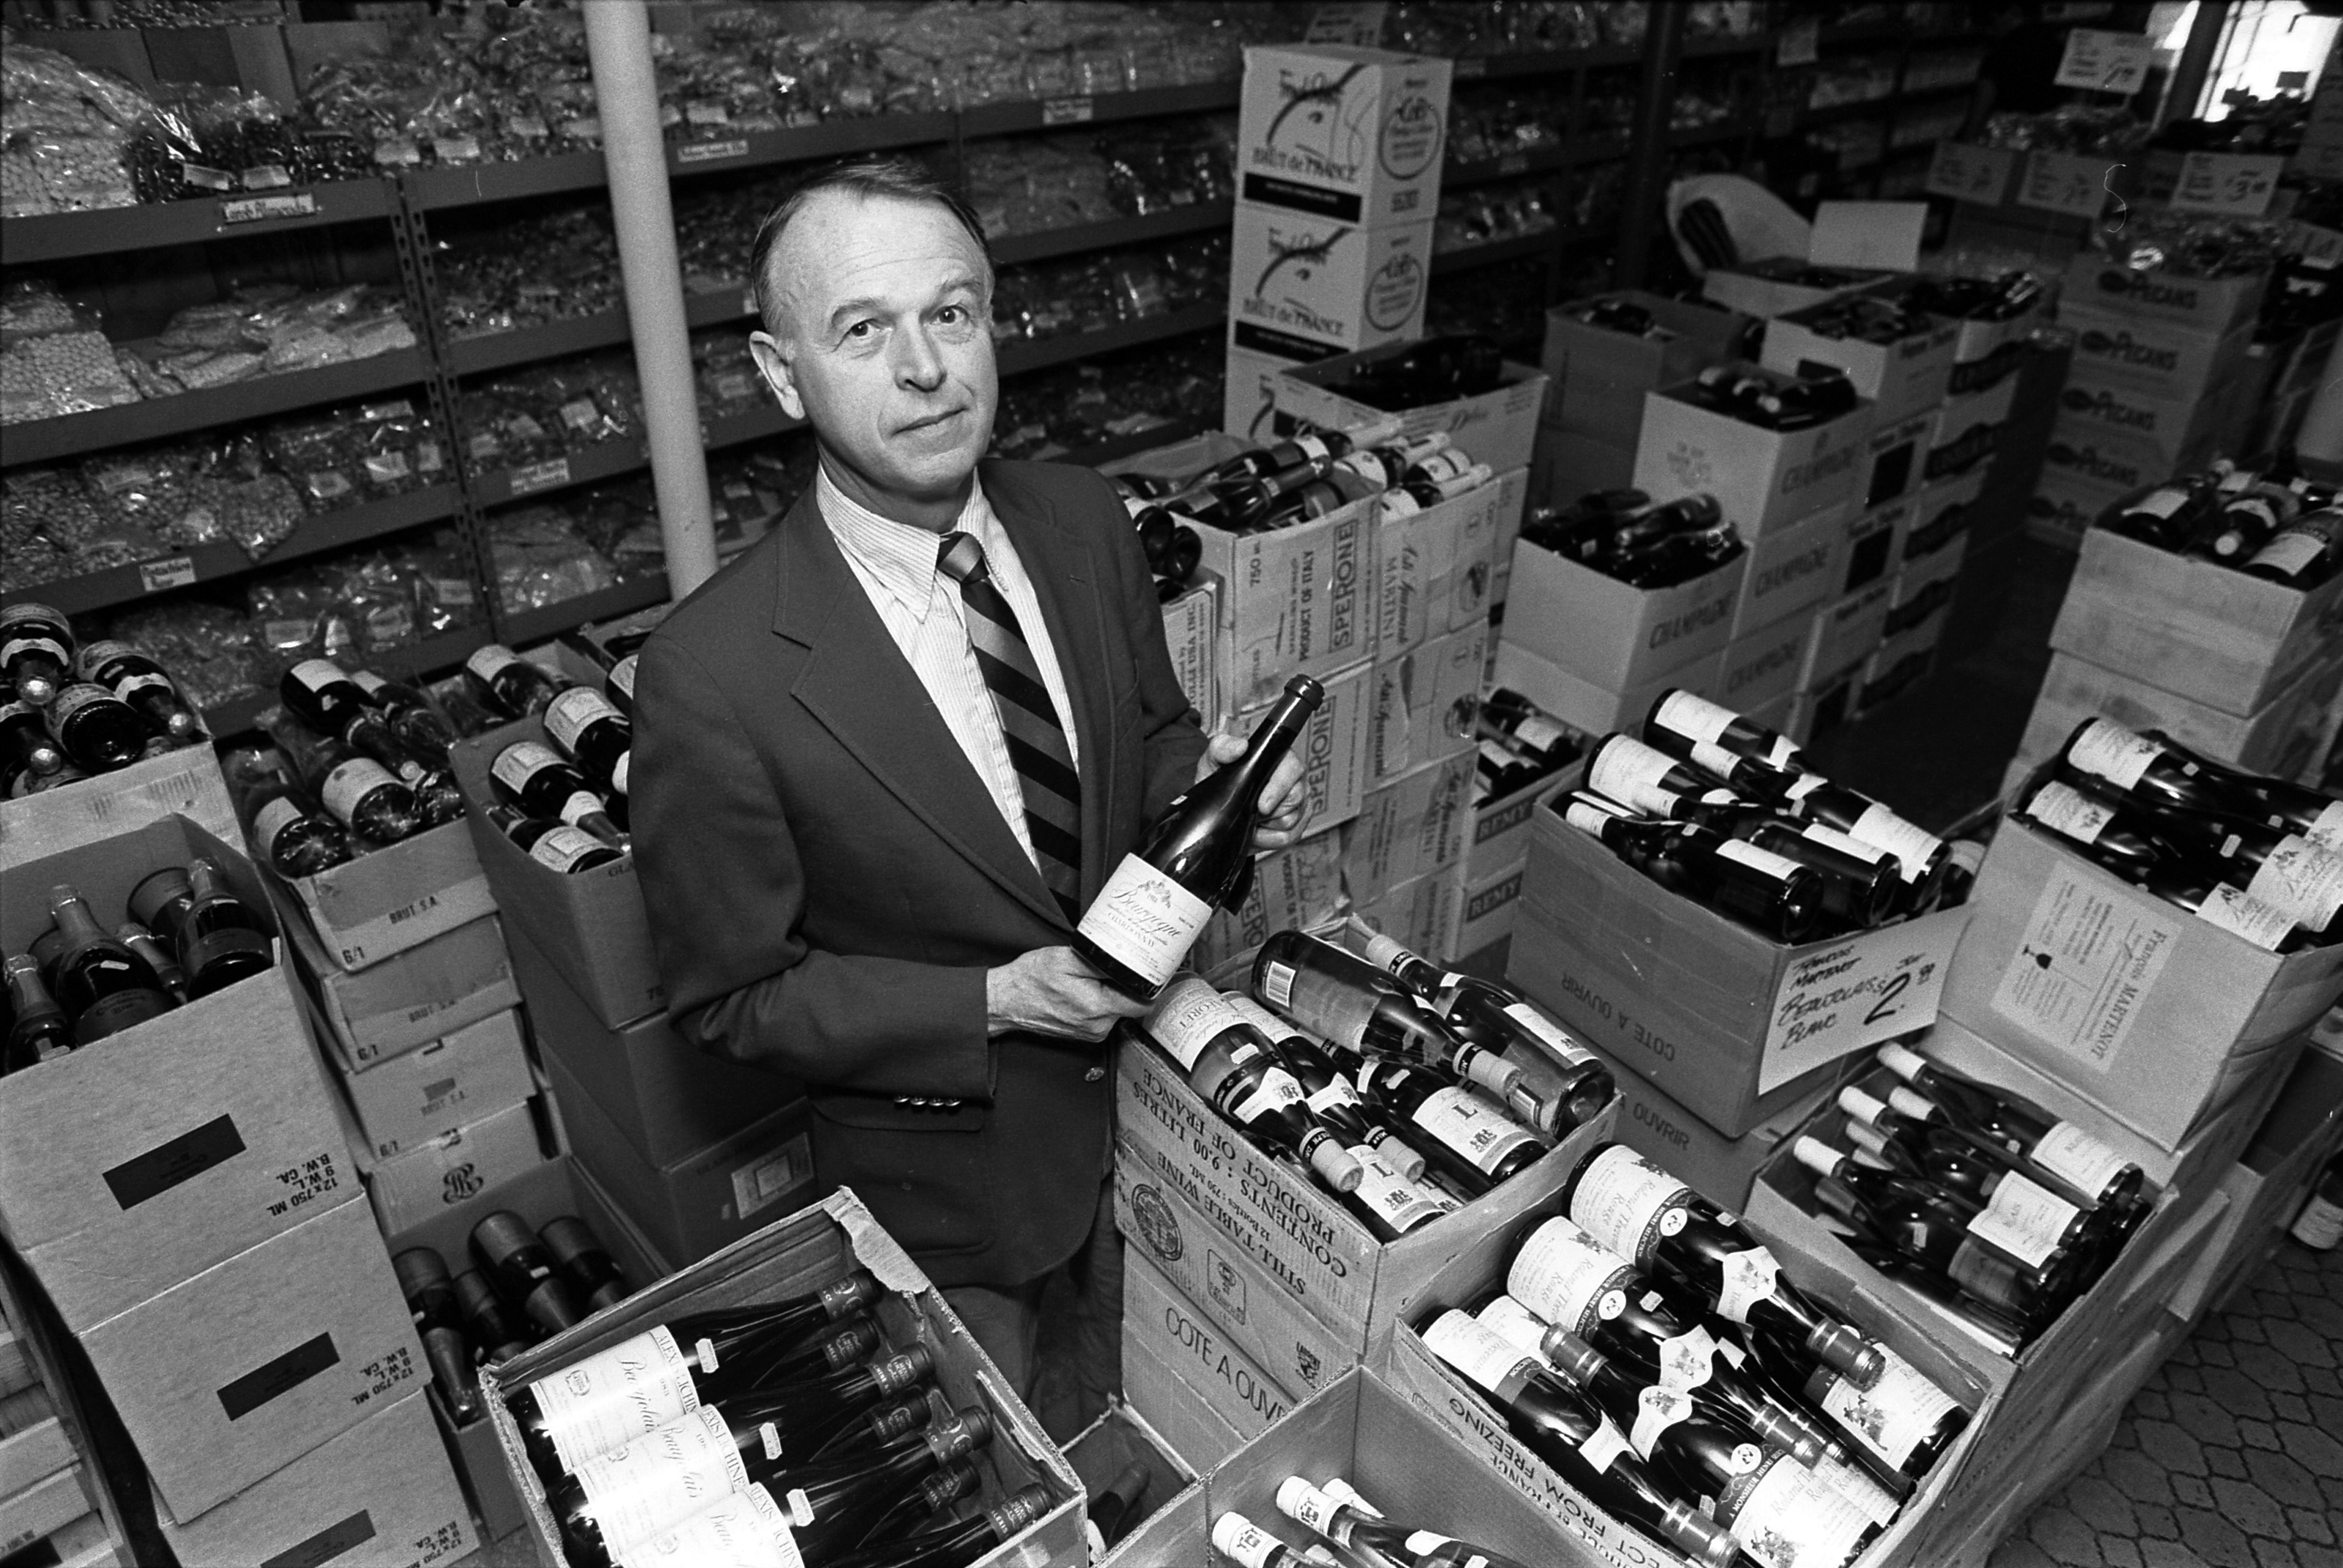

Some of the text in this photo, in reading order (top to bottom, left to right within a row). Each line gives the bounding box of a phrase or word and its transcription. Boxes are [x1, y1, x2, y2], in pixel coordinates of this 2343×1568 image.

[1250, 558, 1261, 587] 750
[1334, 527, 1355, 647] SPERONE
[1382, 557, 1397, 640] MARTINI
[1299, 551, 1314, 662] PRODUCT OF ITALY
[2091, 983, 2139, 1060] MARTENOT
[1133, 1081, 1185, 1143] LITRES
[301, 1153, 331, 1173] B.W.
[325, 1165, 335, 1177] 9
[1143, 1068, 1336, 1247] PRODUCT OF FRANCE
[1157, 1151, 1201, 1203] WINE
[1192, 1139, 1221, 1171] 9.00
[266, 1201, 288, 1217] ML
[1204, 1194, 1256, 1252] TABLE
[1241, 1179, 1348, 1279] CONTENTS
[1259, 1229, 1271, 1242] 12
[1259, 1243, 1306, 1296] STILL
[1165, 1307, 1213, 1366] COTE
[1215, 1354, 1231, 1385] A
[350, 1391, 370, 1405] ML
[1450, 1398, 1606, 1537] FREEZING FROM
[1732, 1476, 1760, 1512] MONSIEUR
[1757, 1458, 1774, 1477] HENRI
